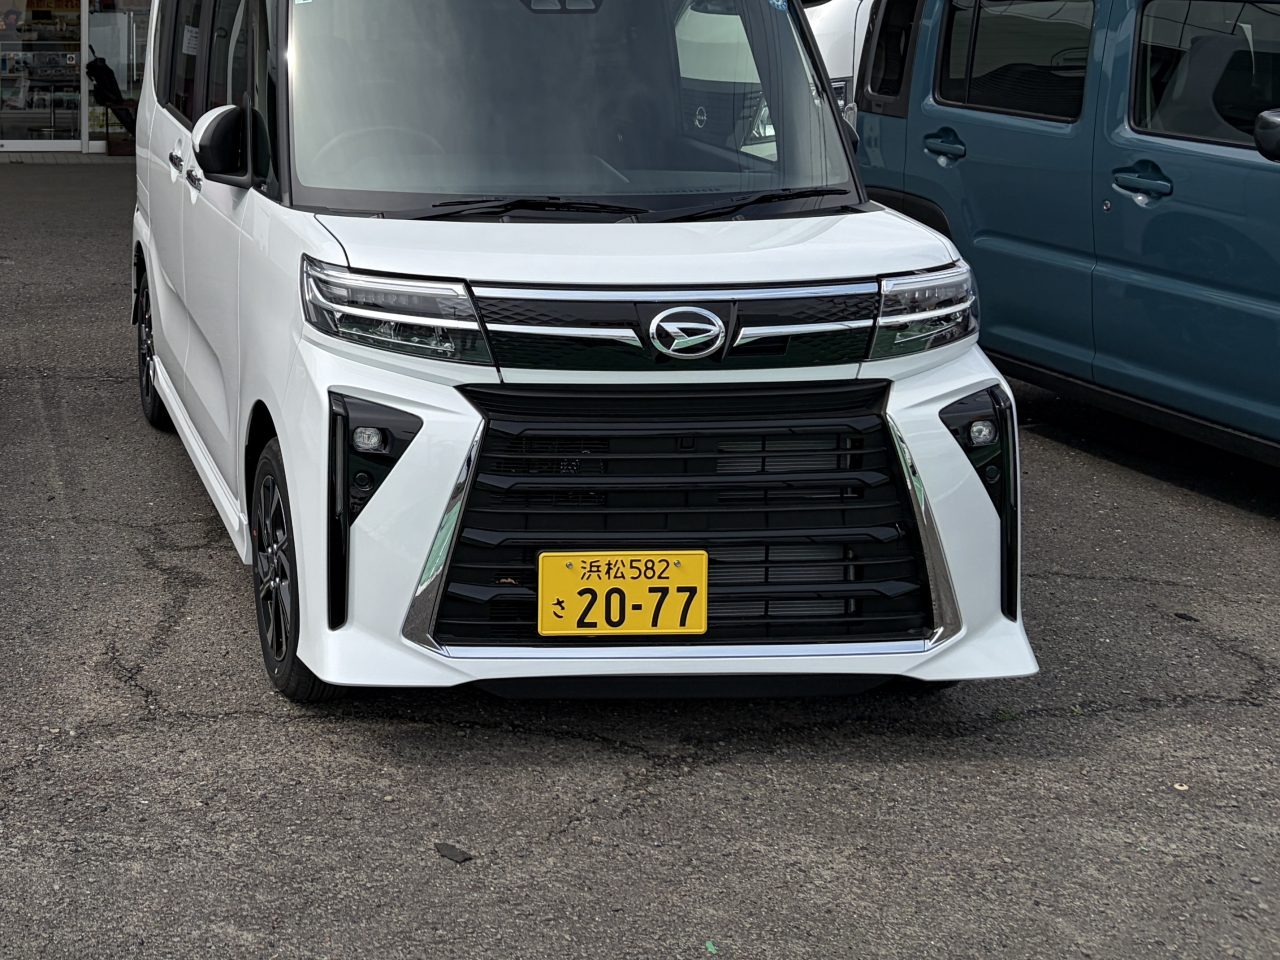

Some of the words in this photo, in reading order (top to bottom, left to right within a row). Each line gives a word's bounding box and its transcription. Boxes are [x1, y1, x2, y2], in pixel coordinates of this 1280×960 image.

[580, 558, 670, 581] 浜松582
[552, 597, 566, 619] さ
[576, 585, 698, 629] 20-77
